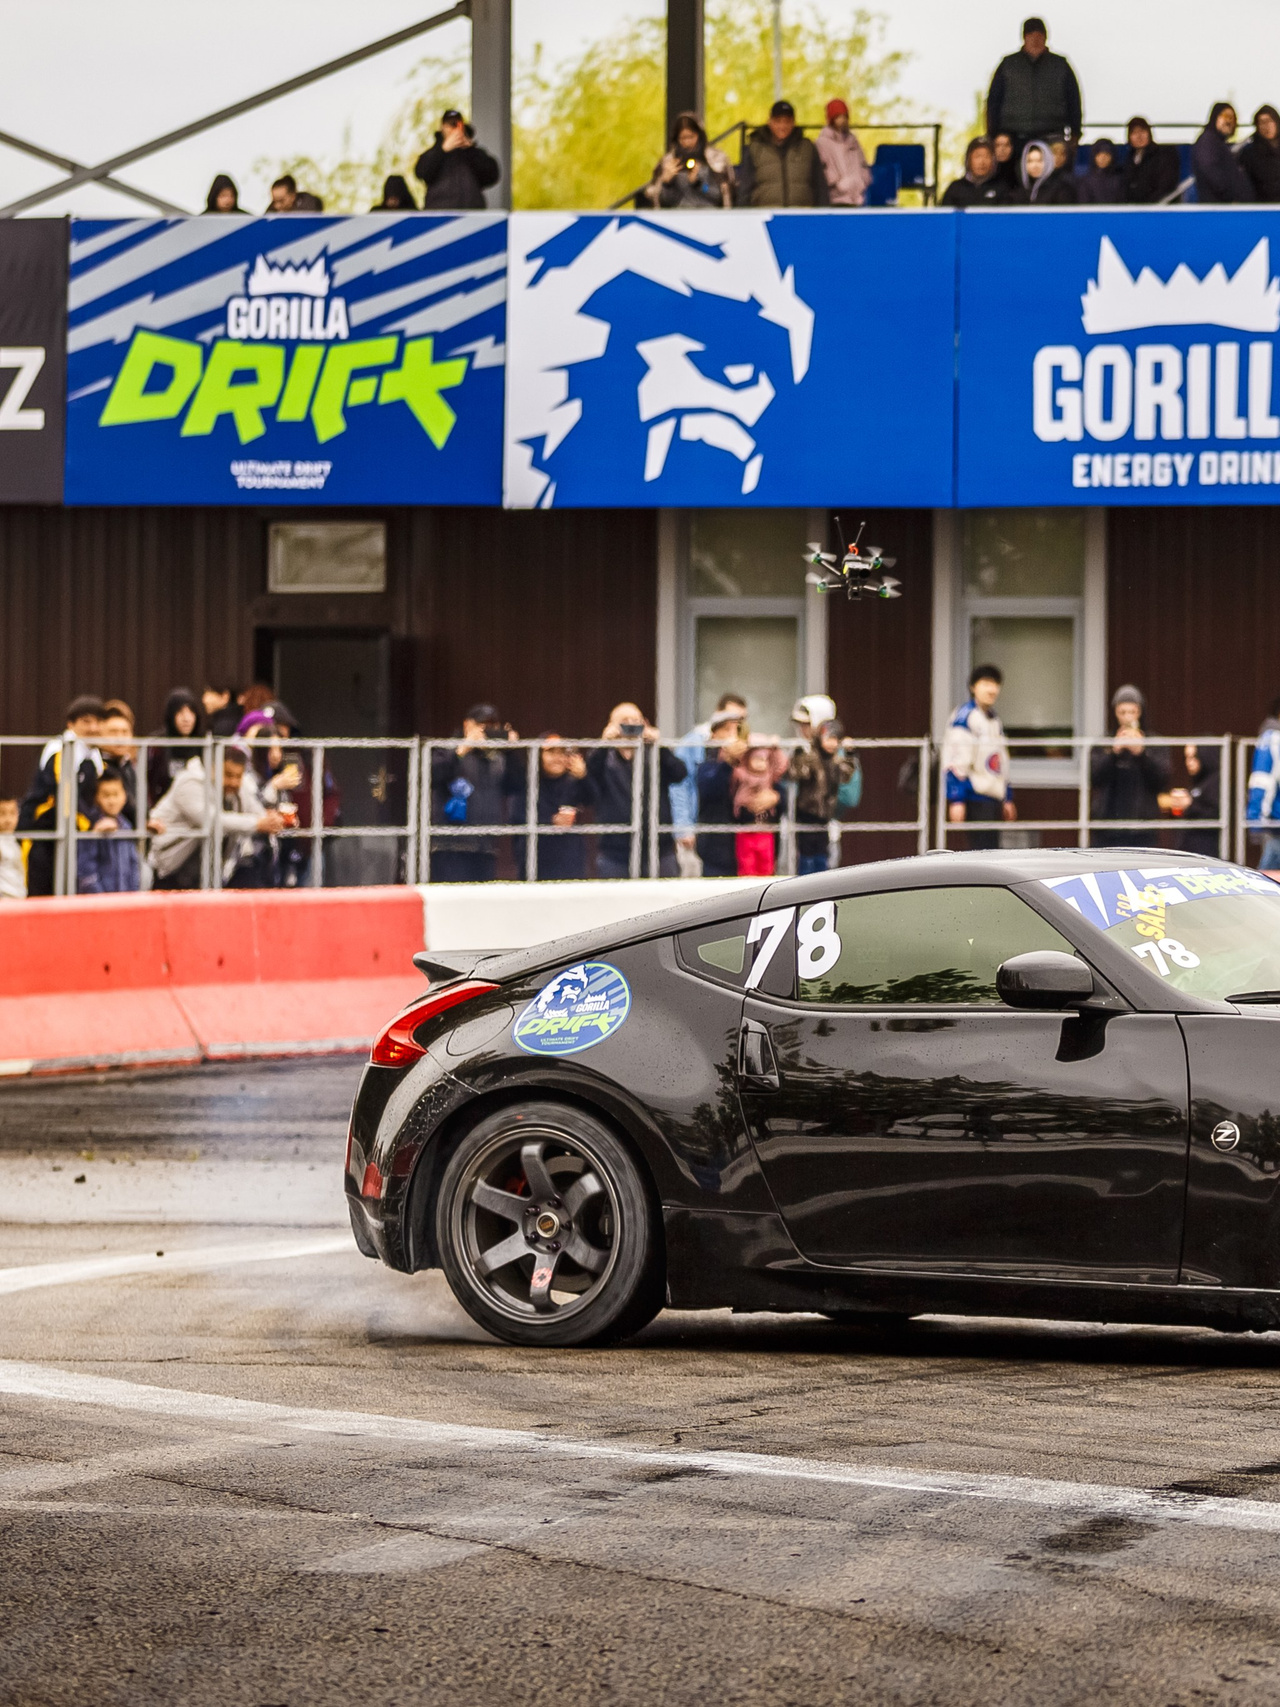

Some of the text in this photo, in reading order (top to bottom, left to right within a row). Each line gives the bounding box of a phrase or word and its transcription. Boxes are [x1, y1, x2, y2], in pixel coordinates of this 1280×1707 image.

[227, 297, 350, 340] GORILLA
[99, 330, 469, 450] DRIFT
[1072, 453, 1194, 488] ENERGY
[744, 901, 843, 989] 78
[1131, 938, 1201, 977] 78
[518, 1012, 617, 1035] DRIFT
[575, 1000, 610, 1013] GORILLA
